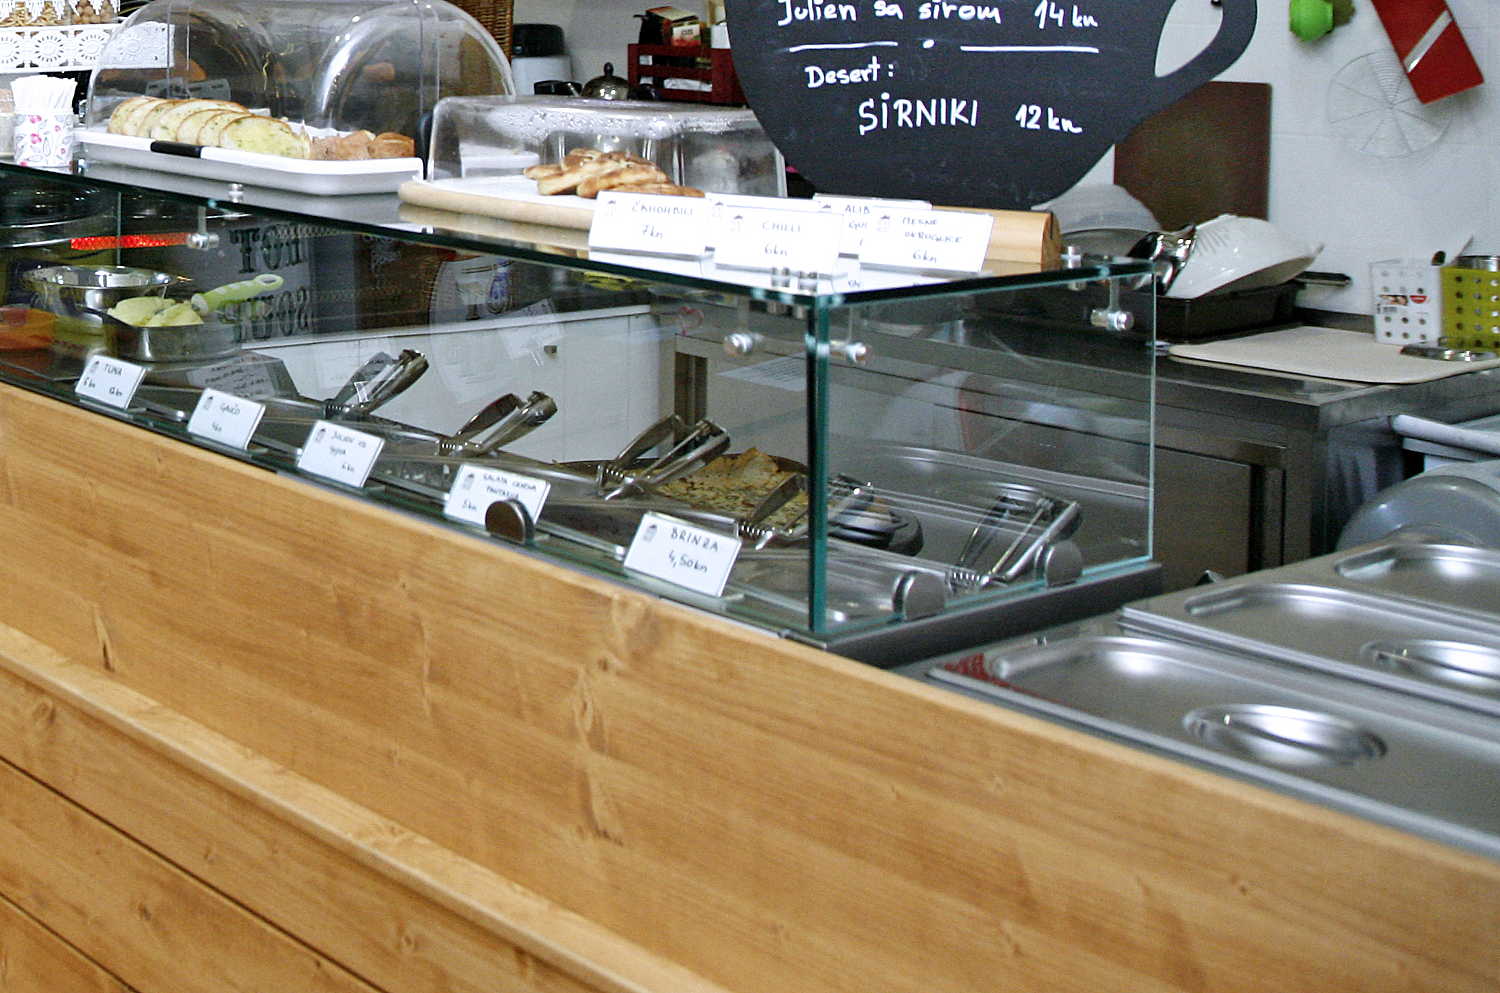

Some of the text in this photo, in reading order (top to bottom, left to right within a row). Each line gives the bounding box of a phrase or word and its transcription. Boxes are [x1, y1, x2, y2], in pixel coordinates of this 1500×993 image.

[874, 0, 903, 20] sa
[1034, 0, 1064, 29] 14
[1072, 5, 1098, 28] kn
[858, 92, 1083, 135] SIRNIKI 12 kn
[104, 363, 123, 377] TUNA
